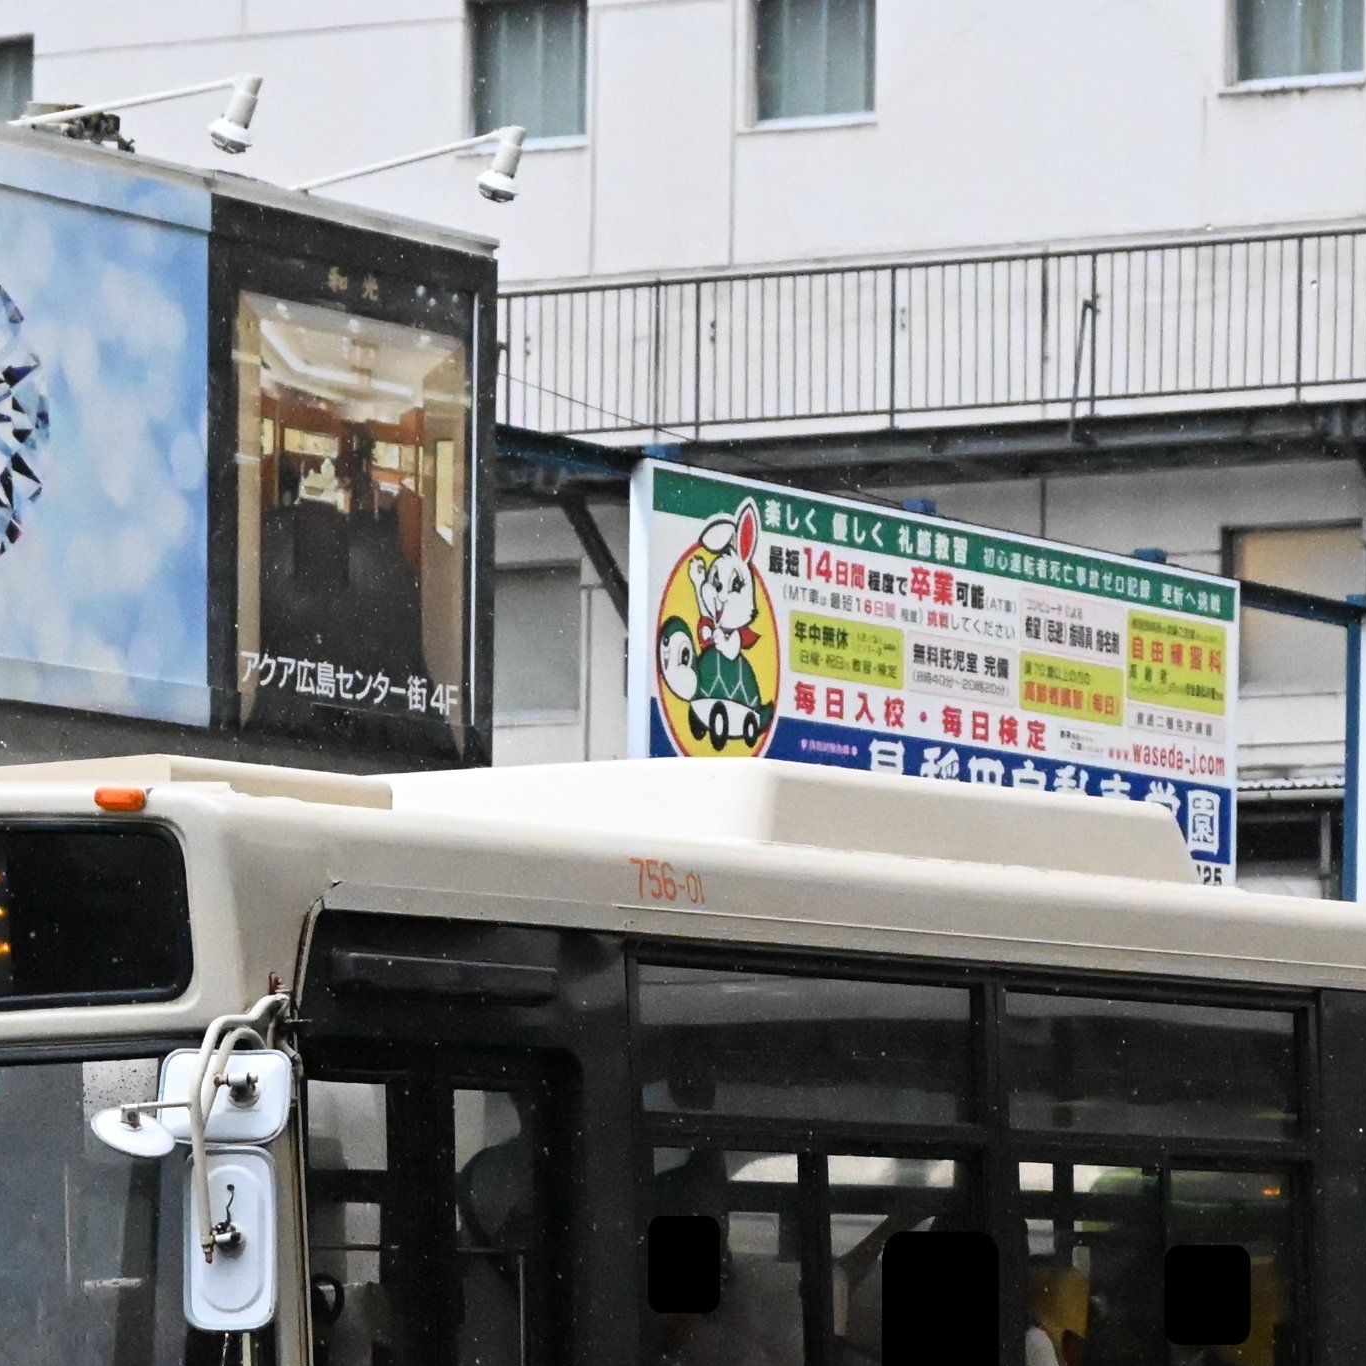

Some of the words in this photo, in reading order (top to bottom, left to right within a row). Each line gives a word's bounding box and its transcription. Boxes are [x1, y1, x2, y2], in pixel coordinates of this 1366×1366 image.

[764, 498, 817, 535] 楽しく
[794, 620, 849, 650] 年中無休
